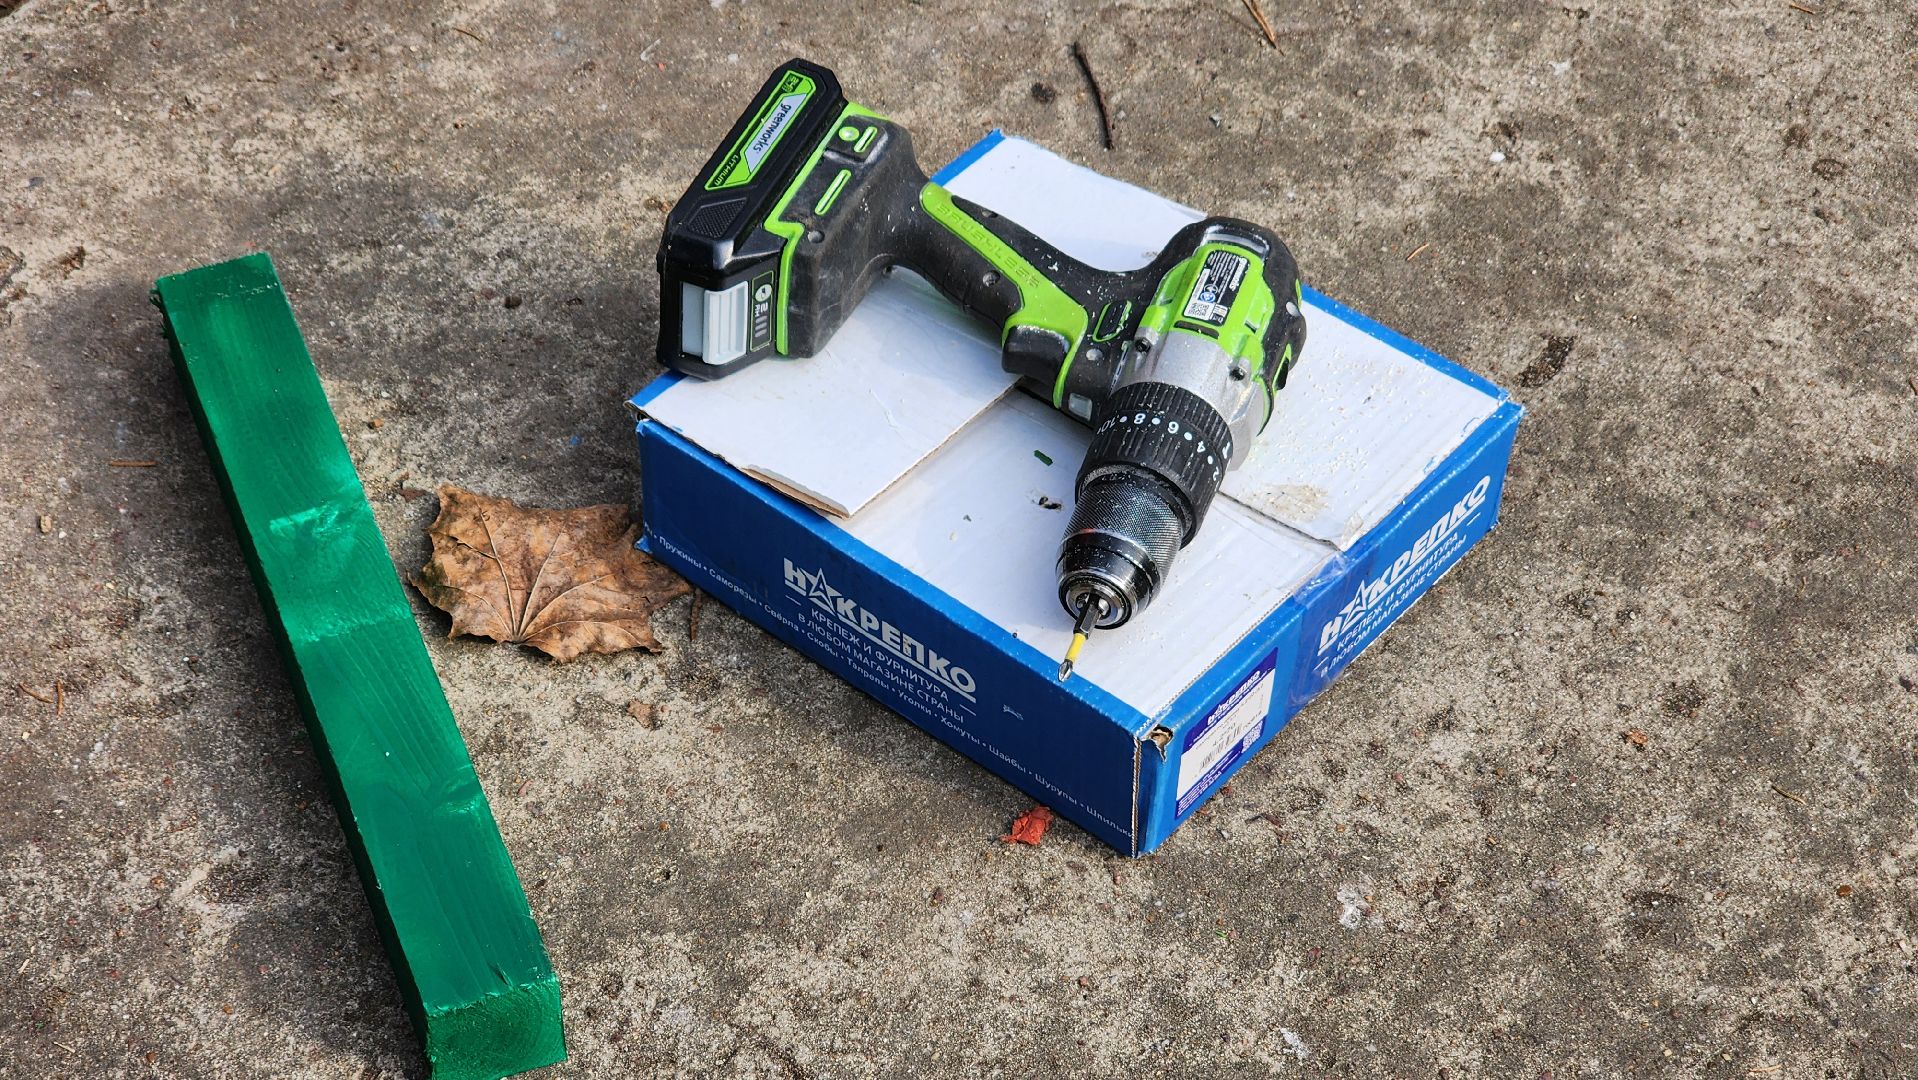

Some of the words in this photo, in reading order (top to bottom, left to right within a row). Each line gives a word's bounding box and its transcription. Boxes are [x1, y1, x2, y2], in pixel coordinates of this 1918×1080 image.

[753, 103, 792, 152] greenworks
[761, 302, 768, 312] 2
[1134, 413, 1146, 425] 8
[1167, 421, 1179, 434] 6
[1197, 441, 1206, 453] 4
[1318, 475, 1491, 653] НАКРЕПКО
[1329, 630, 1375, 672] ЛЮБОМ
[1372, 578, 1426, 632] МАГАЗИНЕ
[1426, 534, 1468, 578] СТРАНЫ
[1337, 604, 1383, 651] КРЕПЕЖ
[1386, 596, 1395, 606] И
[1396, 532, 1459, 597] ФУРНИТУРА
[659, 535, 702, 569] Пружины
[709, 568, 757, 604] Саморезы
[764, 604, 799, 632] Свёрла
[807, 632, 839, 659] Скобы
[898, 689, 932, 715] Уголки
[940, 714, 980, 745] Хомуты
[989, 744, 1026, 774] Шайбы
[1035, 773, 1077, 807] Шурупы
[783, 557, 977, 698] НАКРЕПКО
[798, 612, 806, 623] В
[807, 618, 851, 653] ЛЮБОМ
[853, 649, 915, 694] МАГАЗИНЕ
[917, 688, 964, 724] СТРАНЫ
[811, 608, 861, 648] КРЕПЕЖ
[863, 643, 872, 655] И
[875, 650, 949, 702] ФУРНИТУРА
